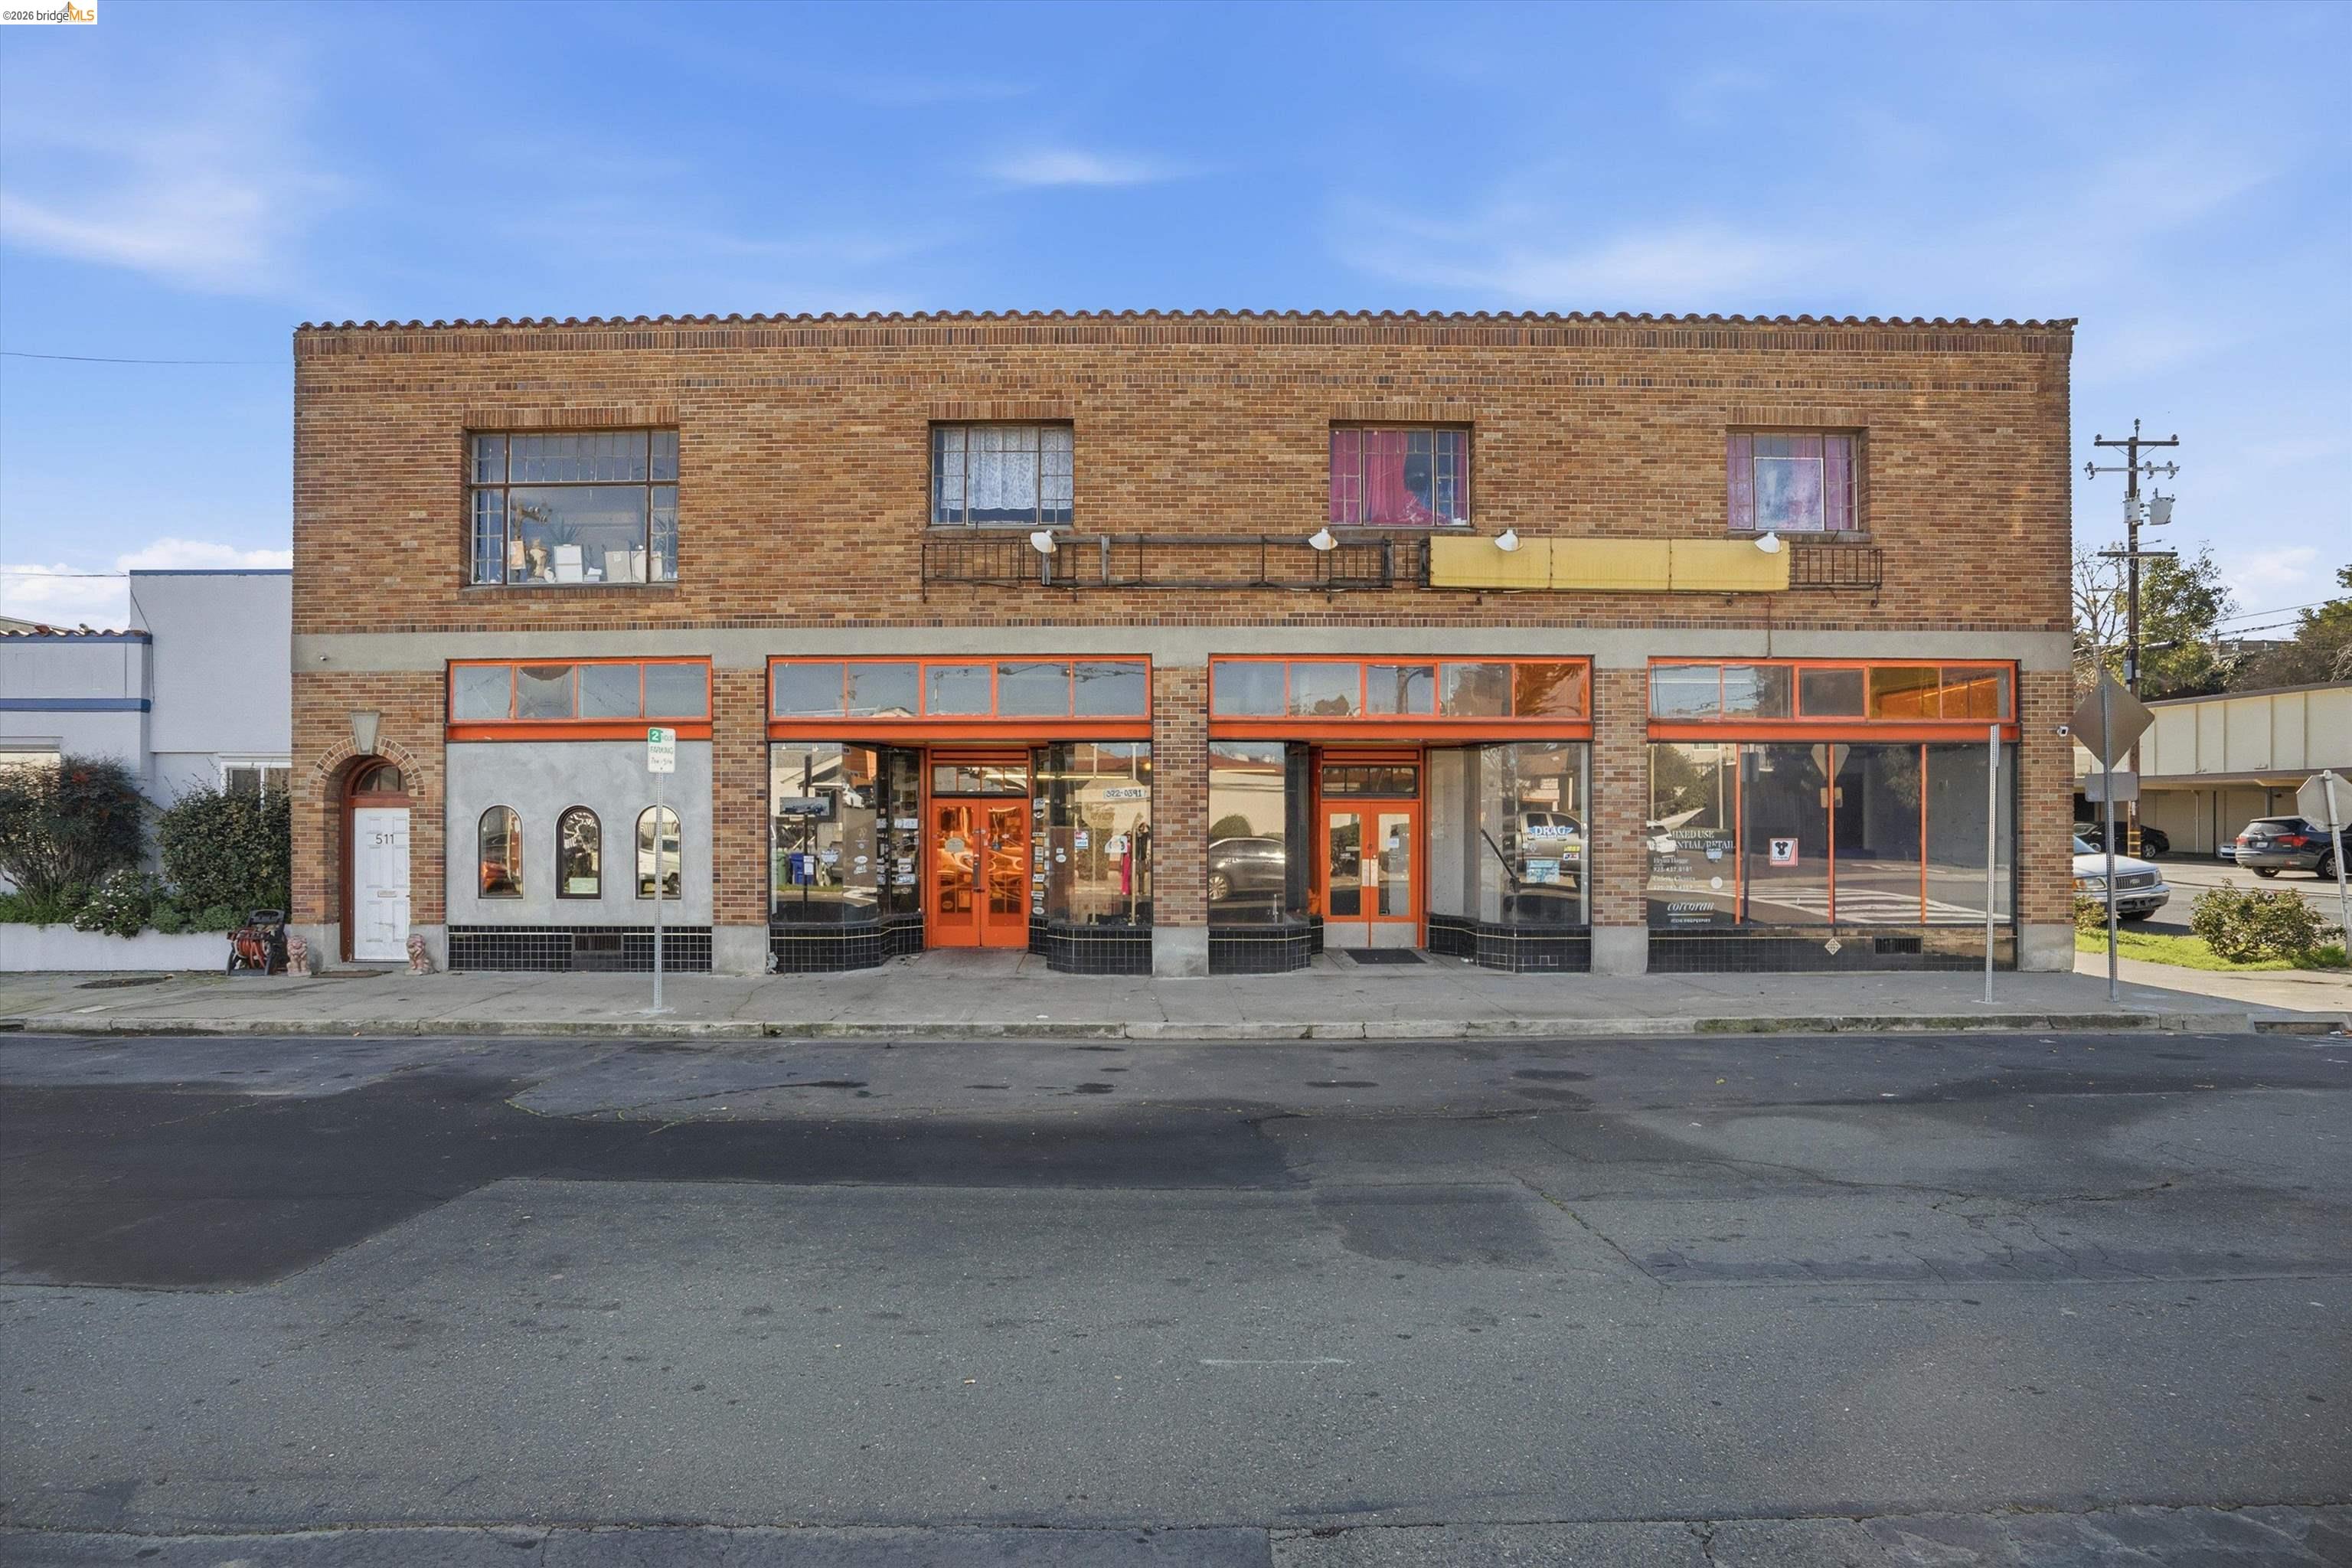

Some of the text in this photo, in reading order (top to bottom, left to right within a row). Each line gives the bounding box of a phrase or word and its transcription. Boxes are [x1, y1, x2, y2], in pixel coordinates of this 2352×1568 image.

[651, 730, 659, 741] 2
[375, 834, 394, 844] 511
[1668, 903, 1714, 911] corcoran
